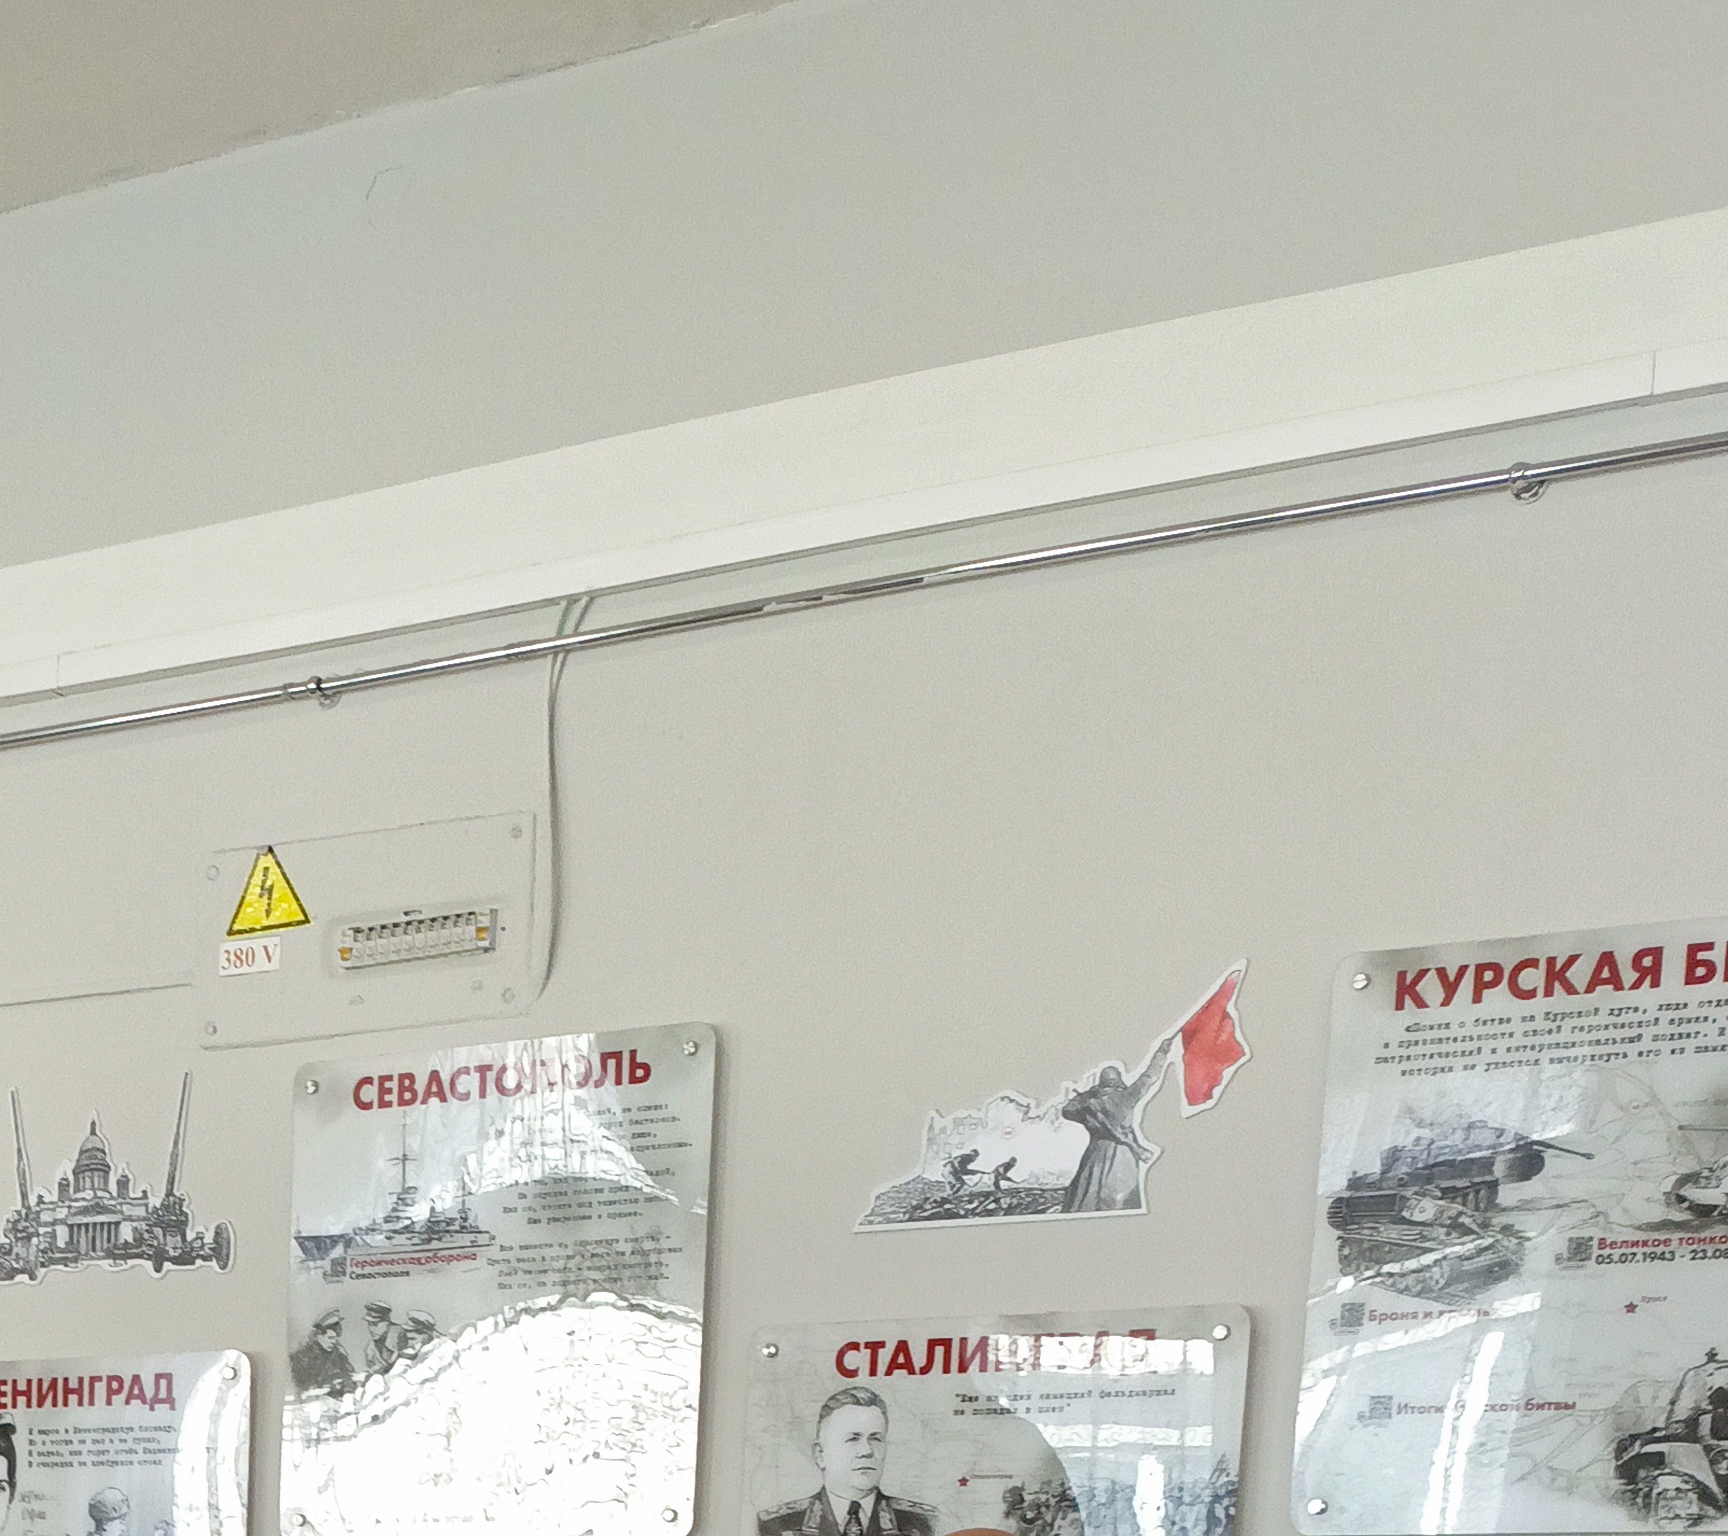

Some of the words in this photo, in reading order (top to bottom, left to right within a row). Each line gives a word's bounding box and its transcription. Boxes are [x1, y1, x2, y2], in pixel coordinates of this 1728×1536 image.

[221, 946, 257, 971] 380
[263, 943, 279, 965] V
[1394, 946, 1665, 1012] КУРСКАЯ
[1684, 940, 1728, 986] Б
[1597, 1237, 1672, 1250] Великое
[1595, 1250, 1676, 1265] 05.07.1943
[1368, 1309, 1419, 1324] Броня
[1396, 1402, 1445, 1416] Итоги
[1524, 1397, 1578, 1412] битвы
